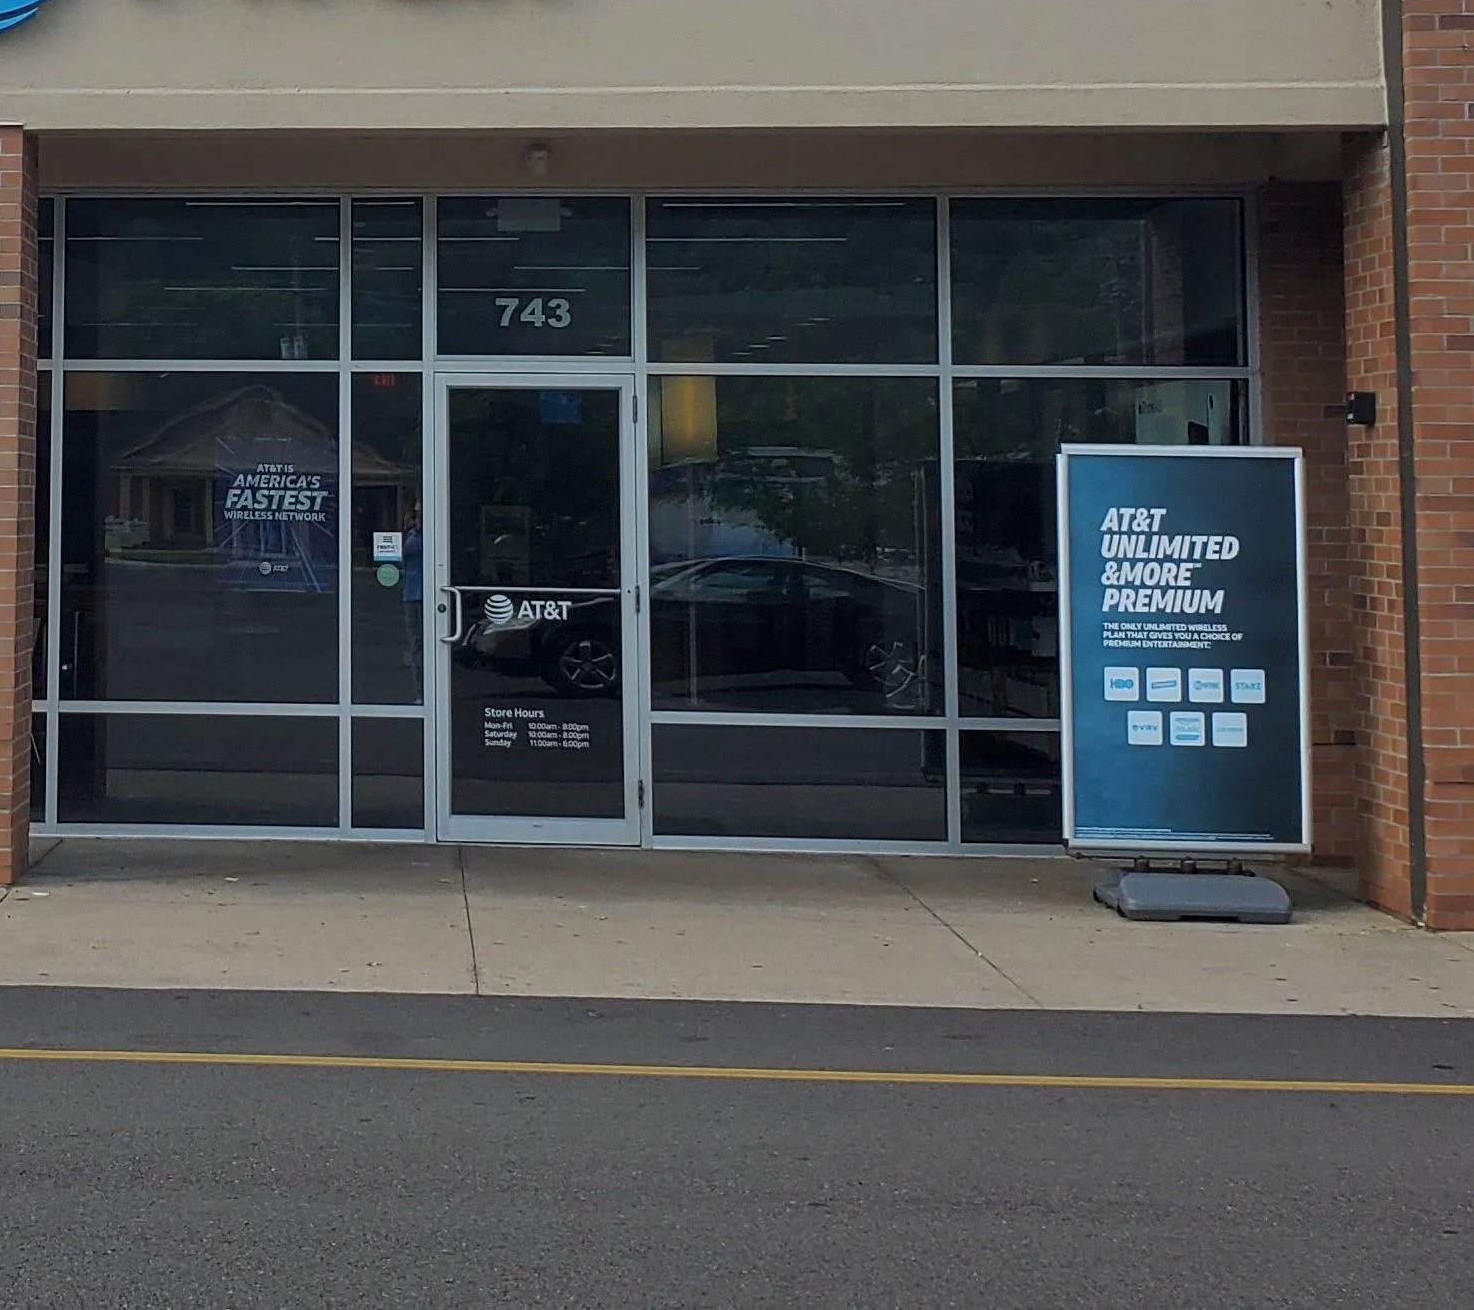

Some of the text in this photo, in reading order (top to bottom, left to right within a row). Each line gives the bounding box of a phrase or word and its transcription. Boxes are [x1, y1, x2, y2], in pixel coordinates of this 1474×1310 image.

[495, 297, 572, 328] 743
[257, 464, 294, 473] AT&T IS
[233, 473, 322, 489] AMERICA'S
[225, 489, 329, 510] FASTEST
[223, 510, 326, 522] WIRELESS NETWORK
[1100, 507, 1167, 532] AT&T
[1100, 534, 1240, 560] UNLIMITED
[1101, 588, 1225, 614] PREMIUM
[517, 600, 572, 620] AT&T
[1102, 622, 1119, 630] THE
[1143, 623, 1187, 631] UNLIMITED
[1187, 624, 1228, 632] WIRELESS
[1102, 631, 1244, 641] PLAN THAT GIVES YOU A CHOICE OF
[1103, 639, 1141, 647] PREMIUM
[1110, 678, 1262, 691] HBO STARZ
[484, 707, 544, 718] Store Hours
[484, 721, 513, 729] Mon-Fri
[484, 730, 517, 739] Saturday
[484, 738, 512, 748] Sunday
